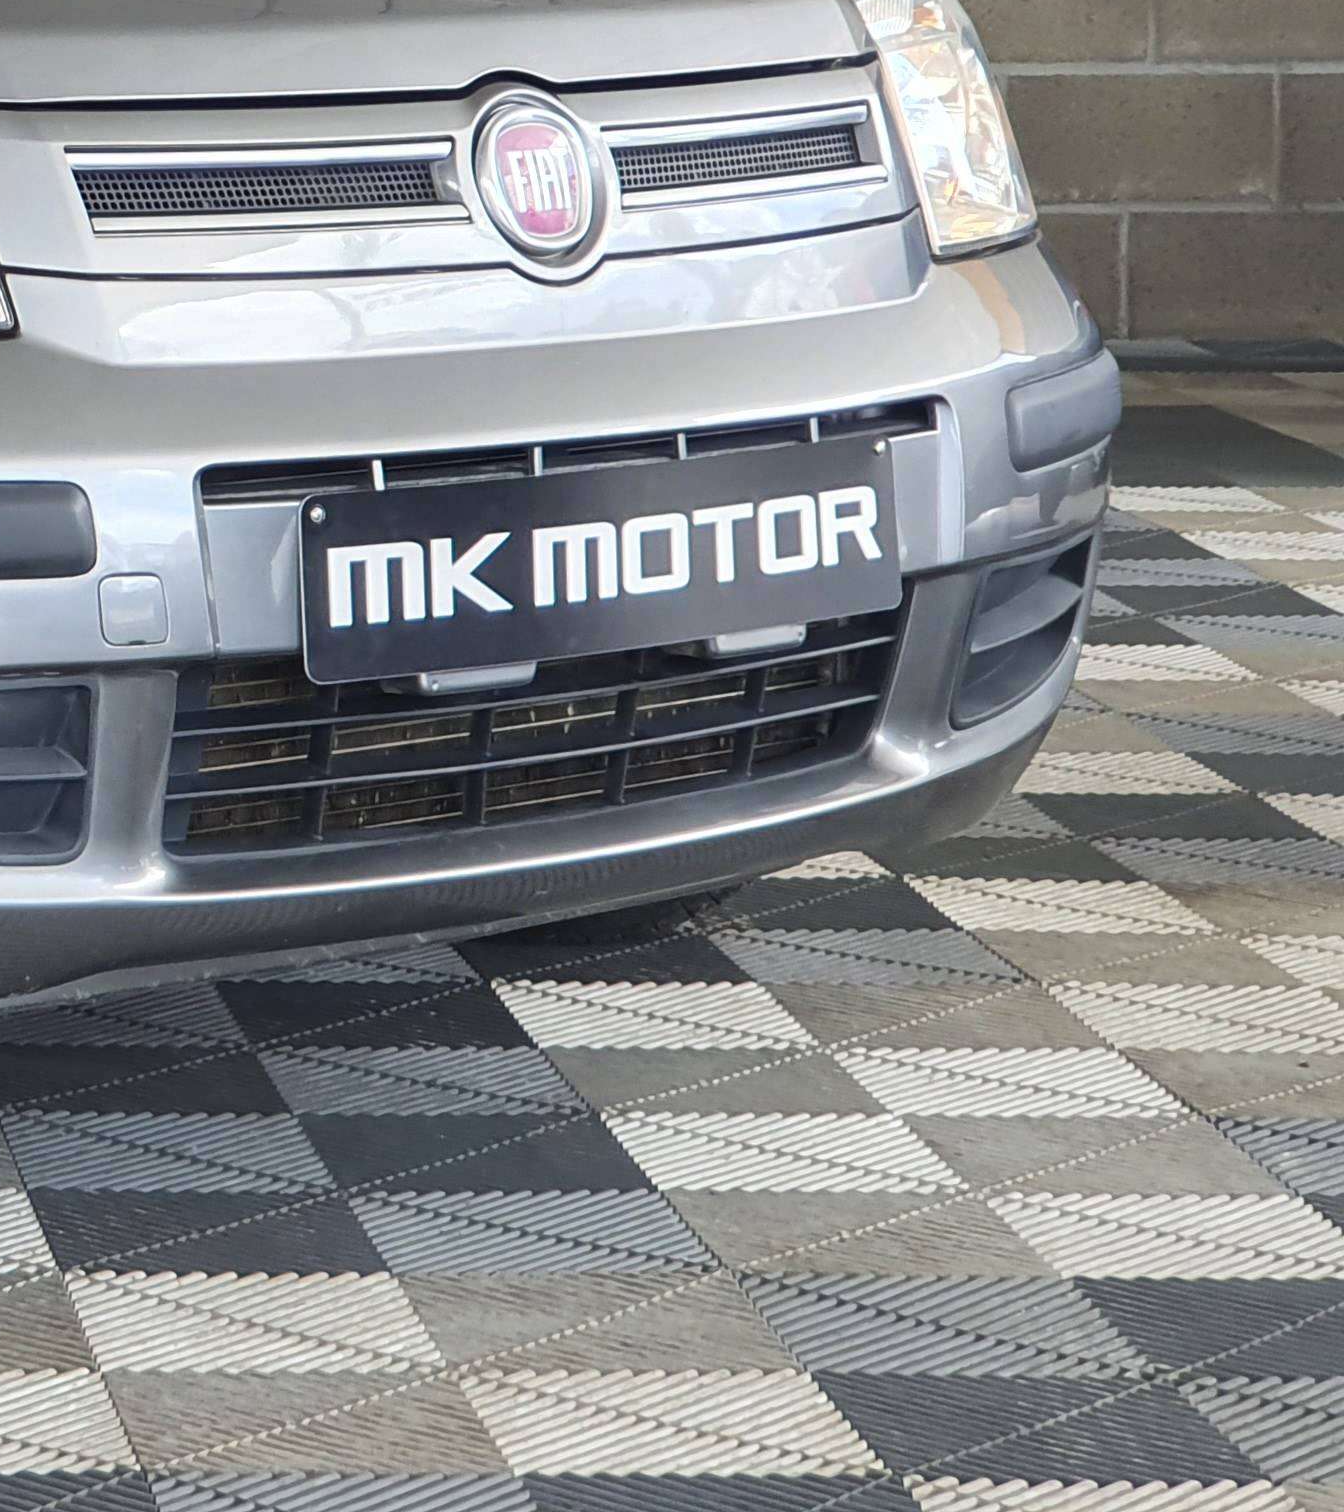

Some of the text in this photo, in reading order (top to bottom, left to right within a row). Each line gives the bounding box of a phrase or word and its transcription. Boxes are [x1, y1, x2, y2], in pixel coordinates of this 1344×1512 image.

[506, 146, 573, 214] FIAT
[326, 484, 884, 629] MK MOTOR
